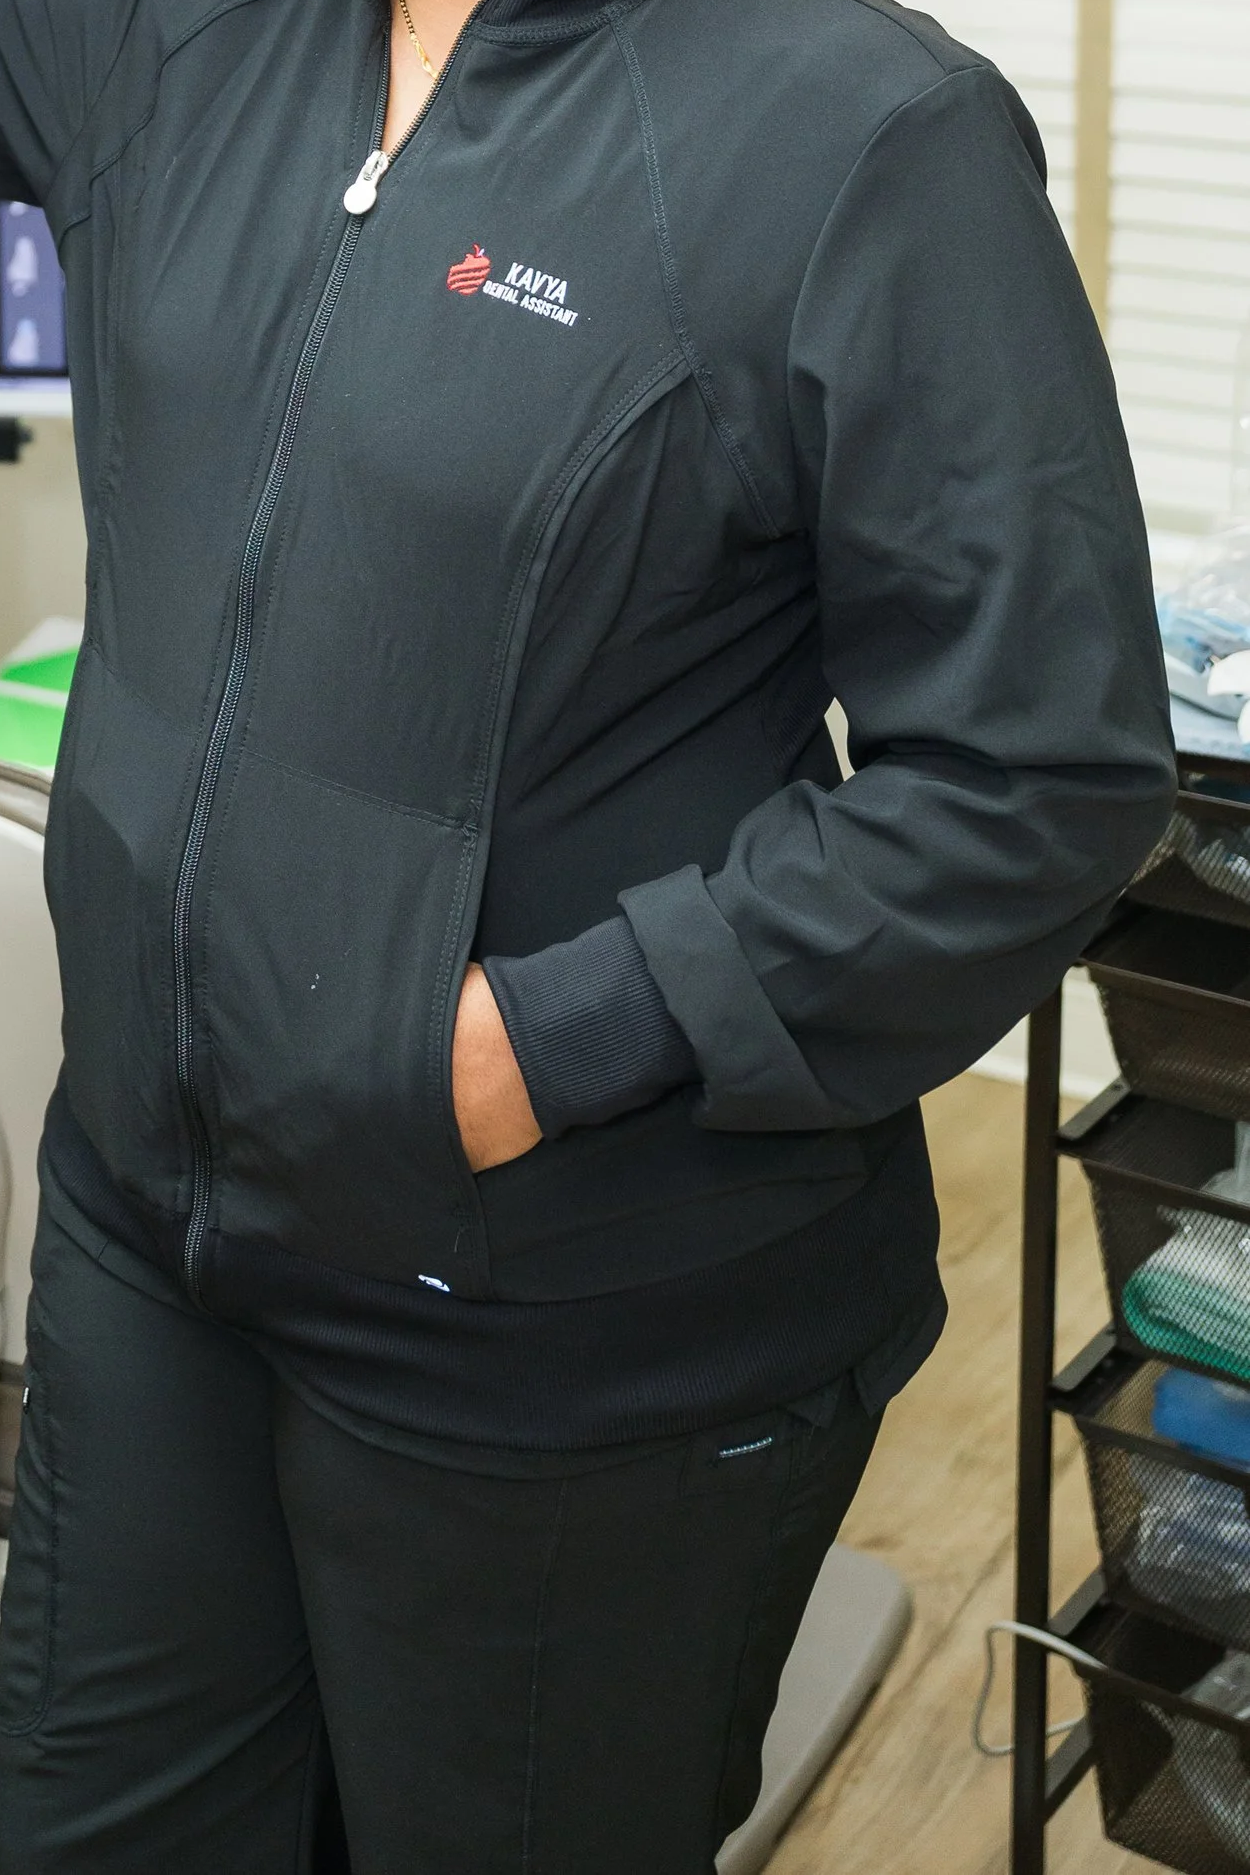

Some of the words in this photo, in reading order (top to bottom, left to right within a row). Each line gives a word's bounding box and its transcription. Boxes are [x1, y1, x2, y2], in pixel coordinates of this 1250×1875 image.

[483, 280, 518, 304] DENTAL
[520, 294, 578, 326] ASSISTANT
[505, 262, 567, 304] KAVYA
